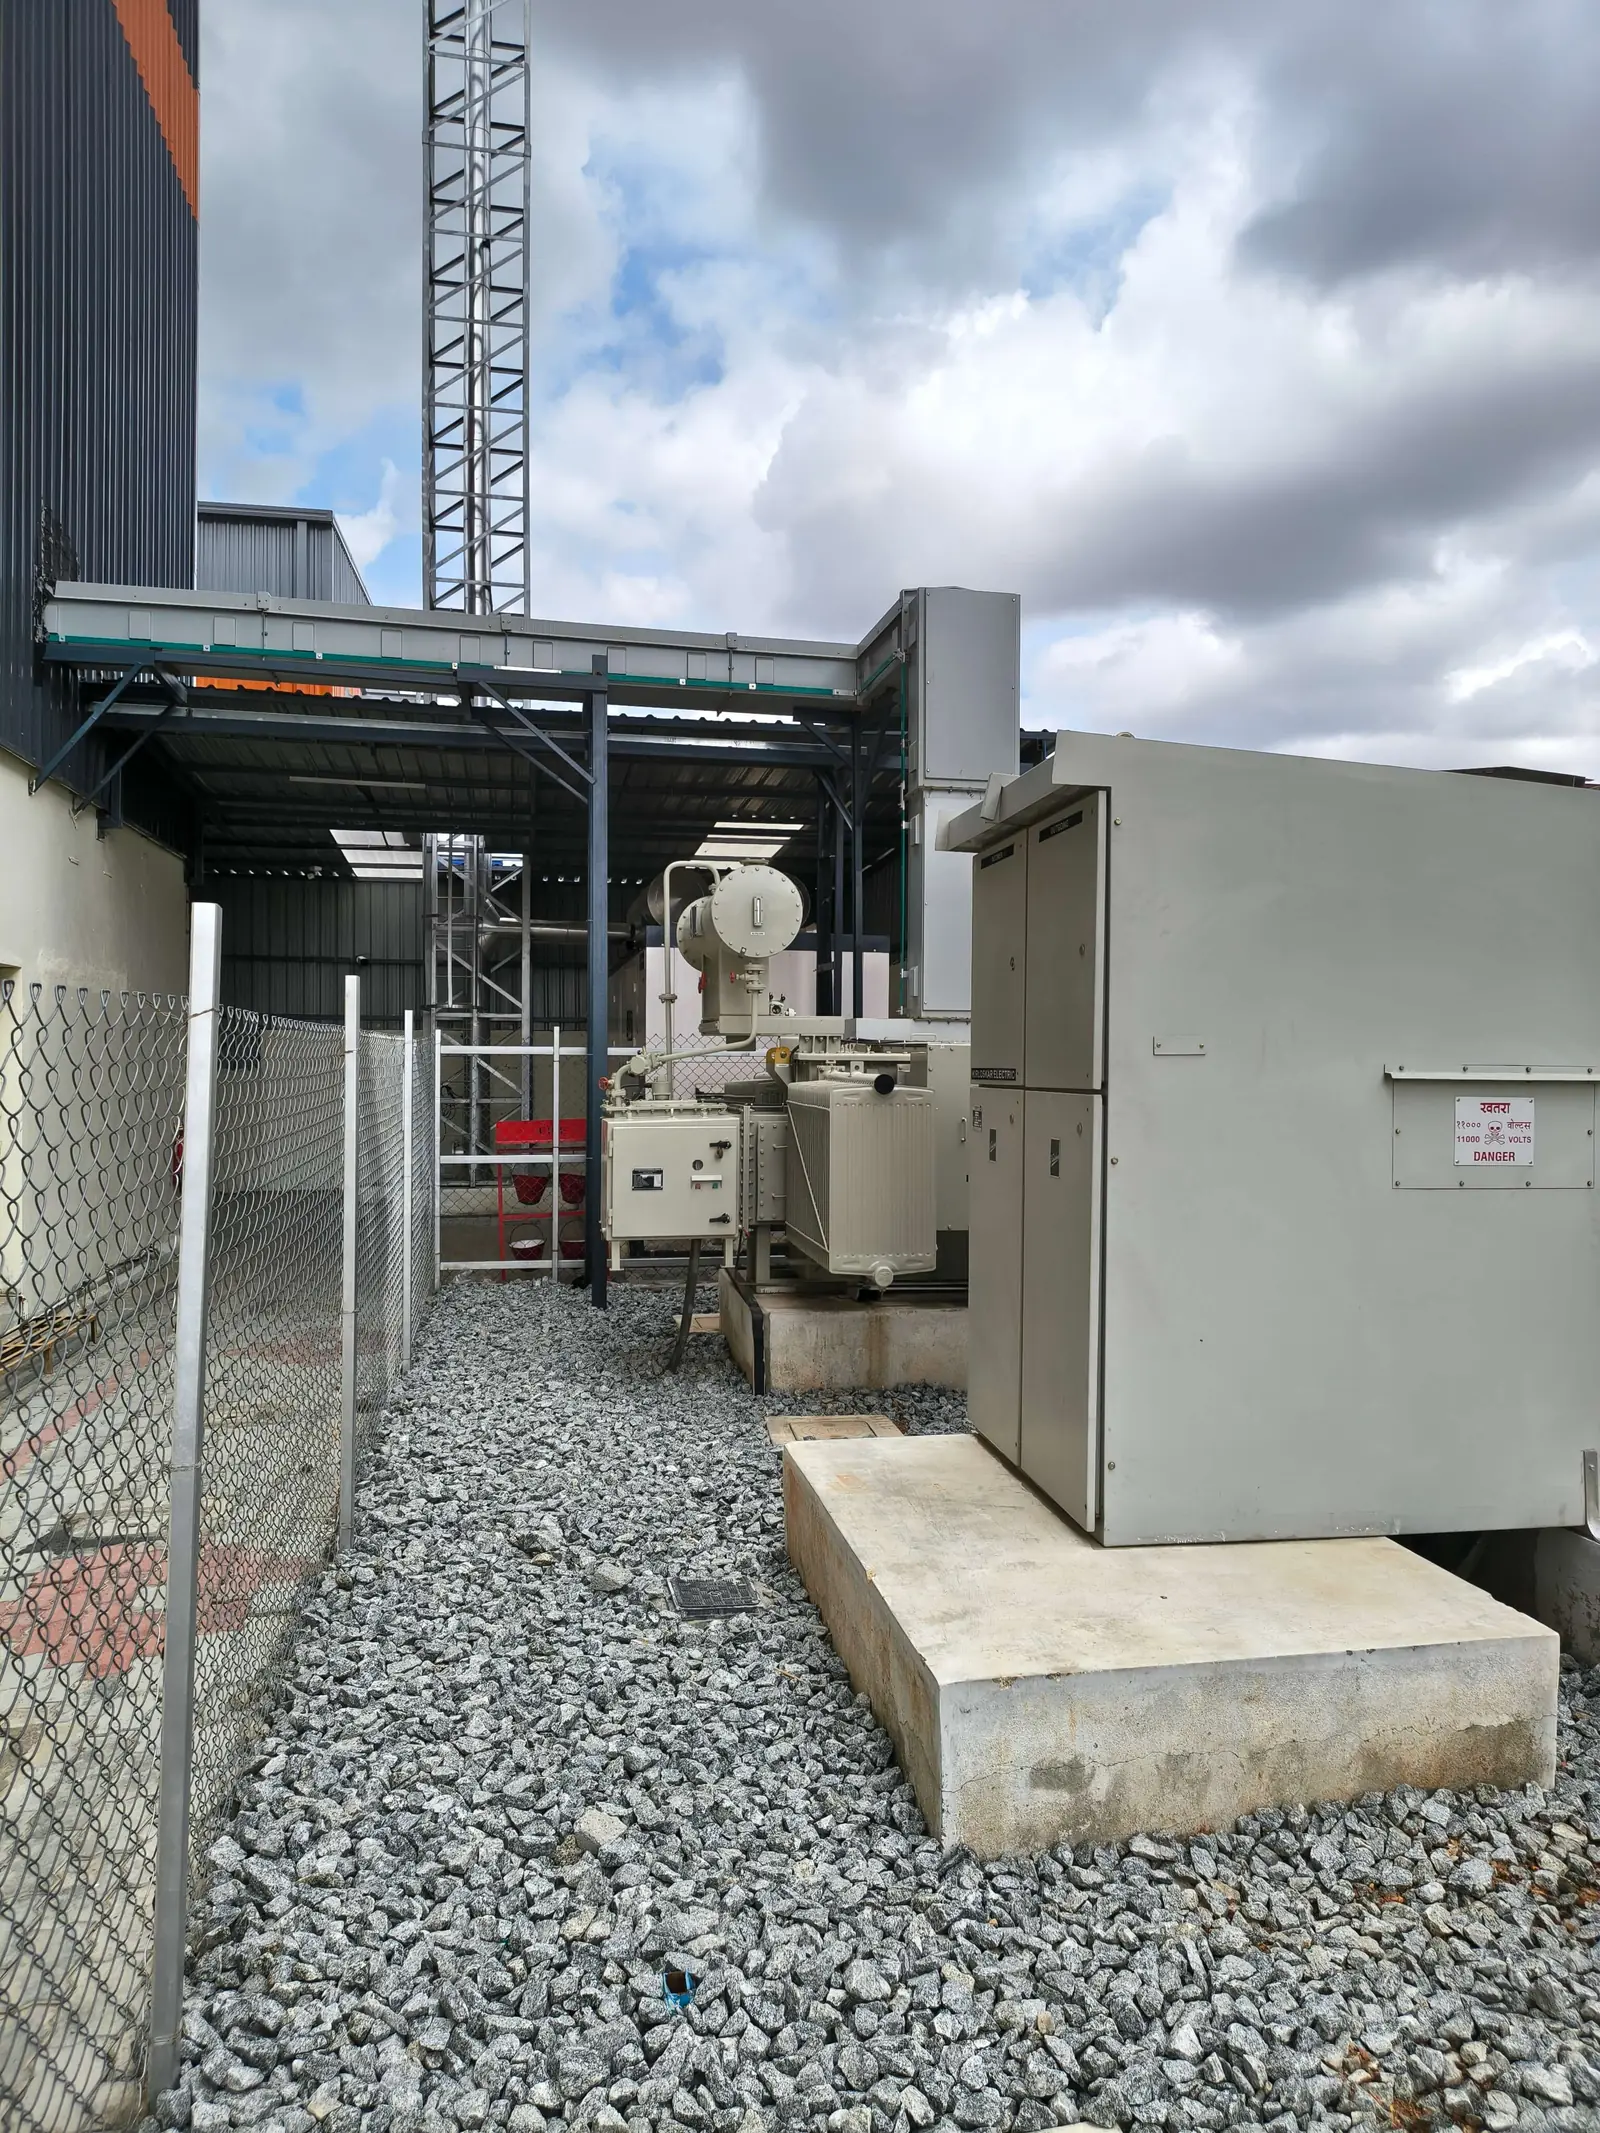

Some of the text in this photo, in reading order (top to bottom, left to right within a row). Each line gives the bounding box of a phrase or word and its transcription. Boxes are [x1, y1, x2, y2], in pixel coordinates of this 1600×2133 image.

[993, 1069, 1016, 1080] ELECTRIC
[1480, 1102, 1511, 1114] खतरा
[1456, 1120, 1481, 1130] ११०००
[1456, 1135, 1532, 1144] 11000 VOLTS
[1473, 1151, 1516, 1162] DANGER
